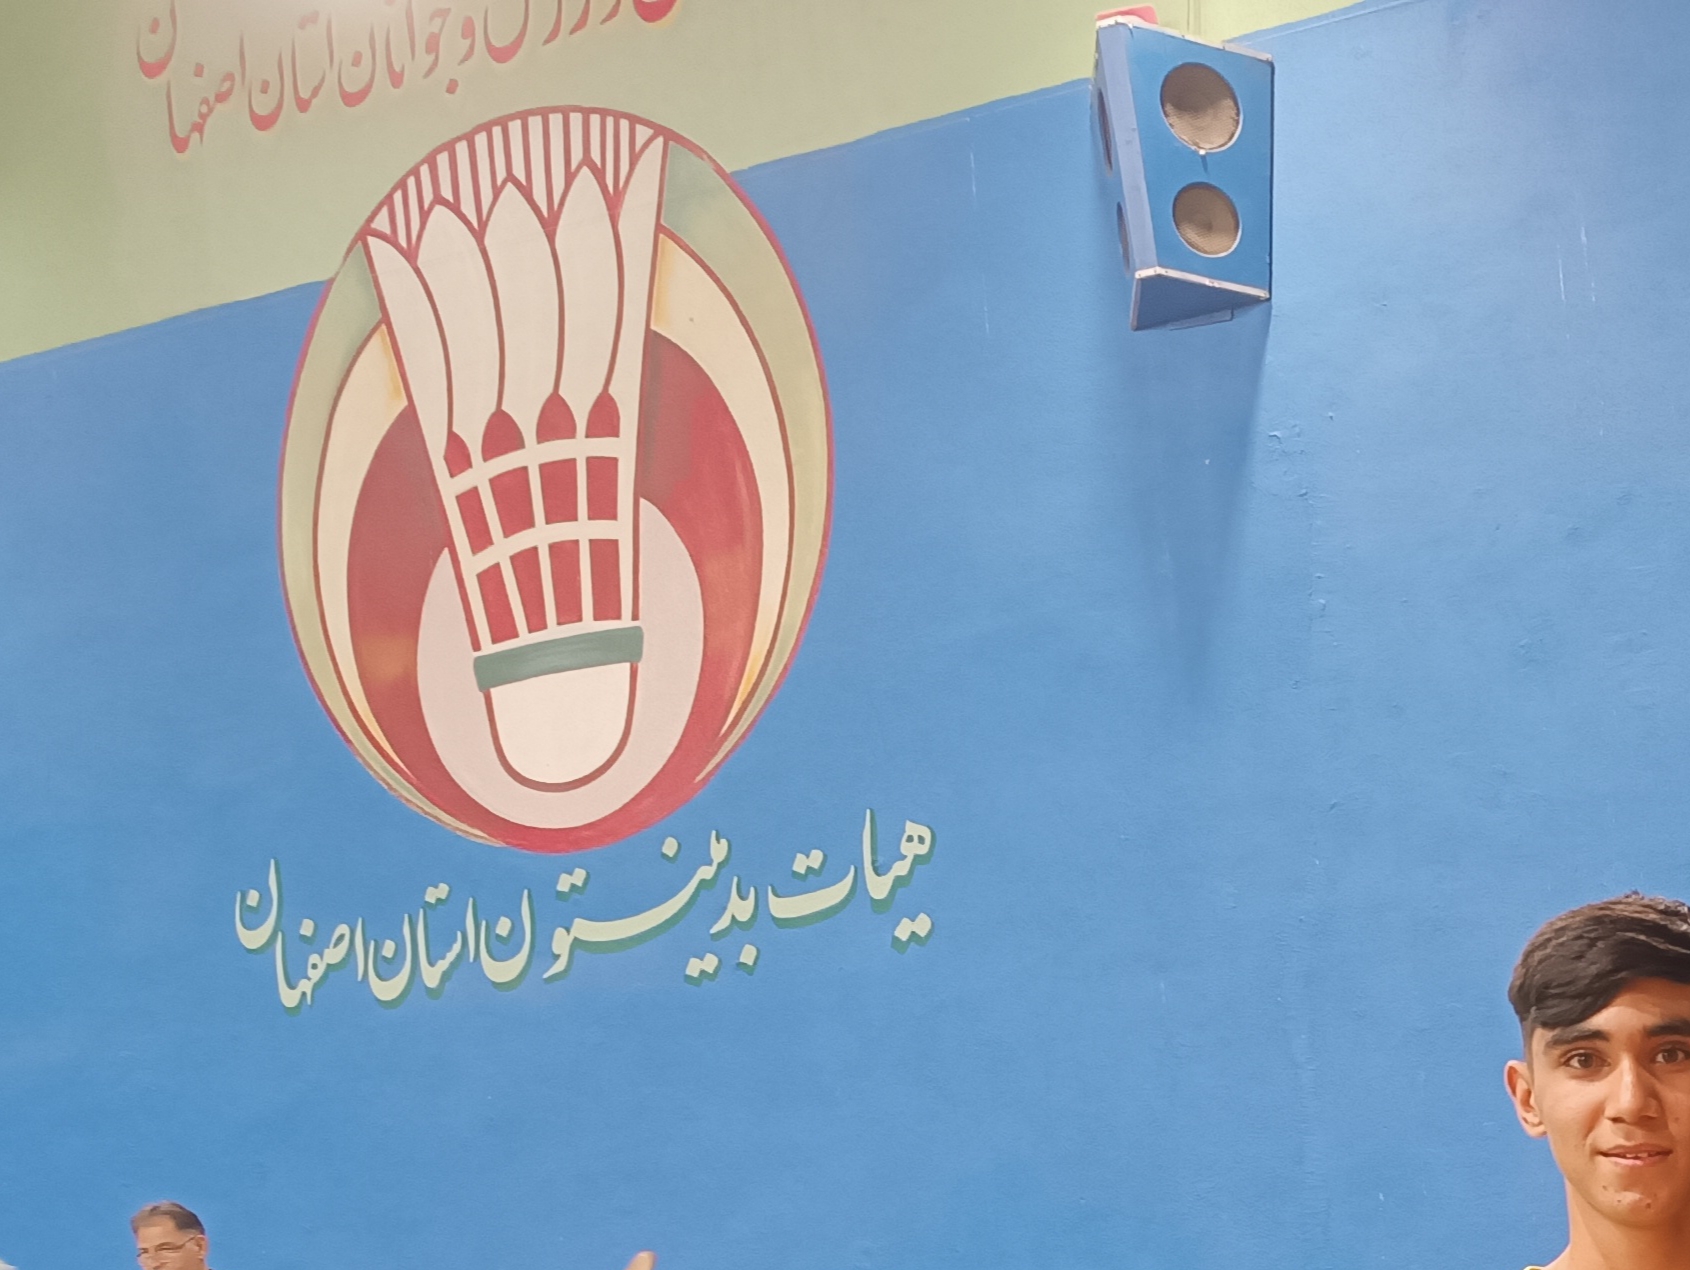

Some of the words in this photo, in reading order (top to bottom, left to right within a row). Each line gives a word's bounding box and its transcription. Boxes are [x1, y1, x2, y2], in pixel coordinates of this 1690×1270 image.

[136, 0, 246, 154] اصفهان
[248, 10, 334, 132] استان
[337, 0, 460, 108] جوانان
[234, 858, 366, 1010] اصفهان
[367, 882, 477, 1004] استان
[479, 830, 758, 986] بدمینتون
